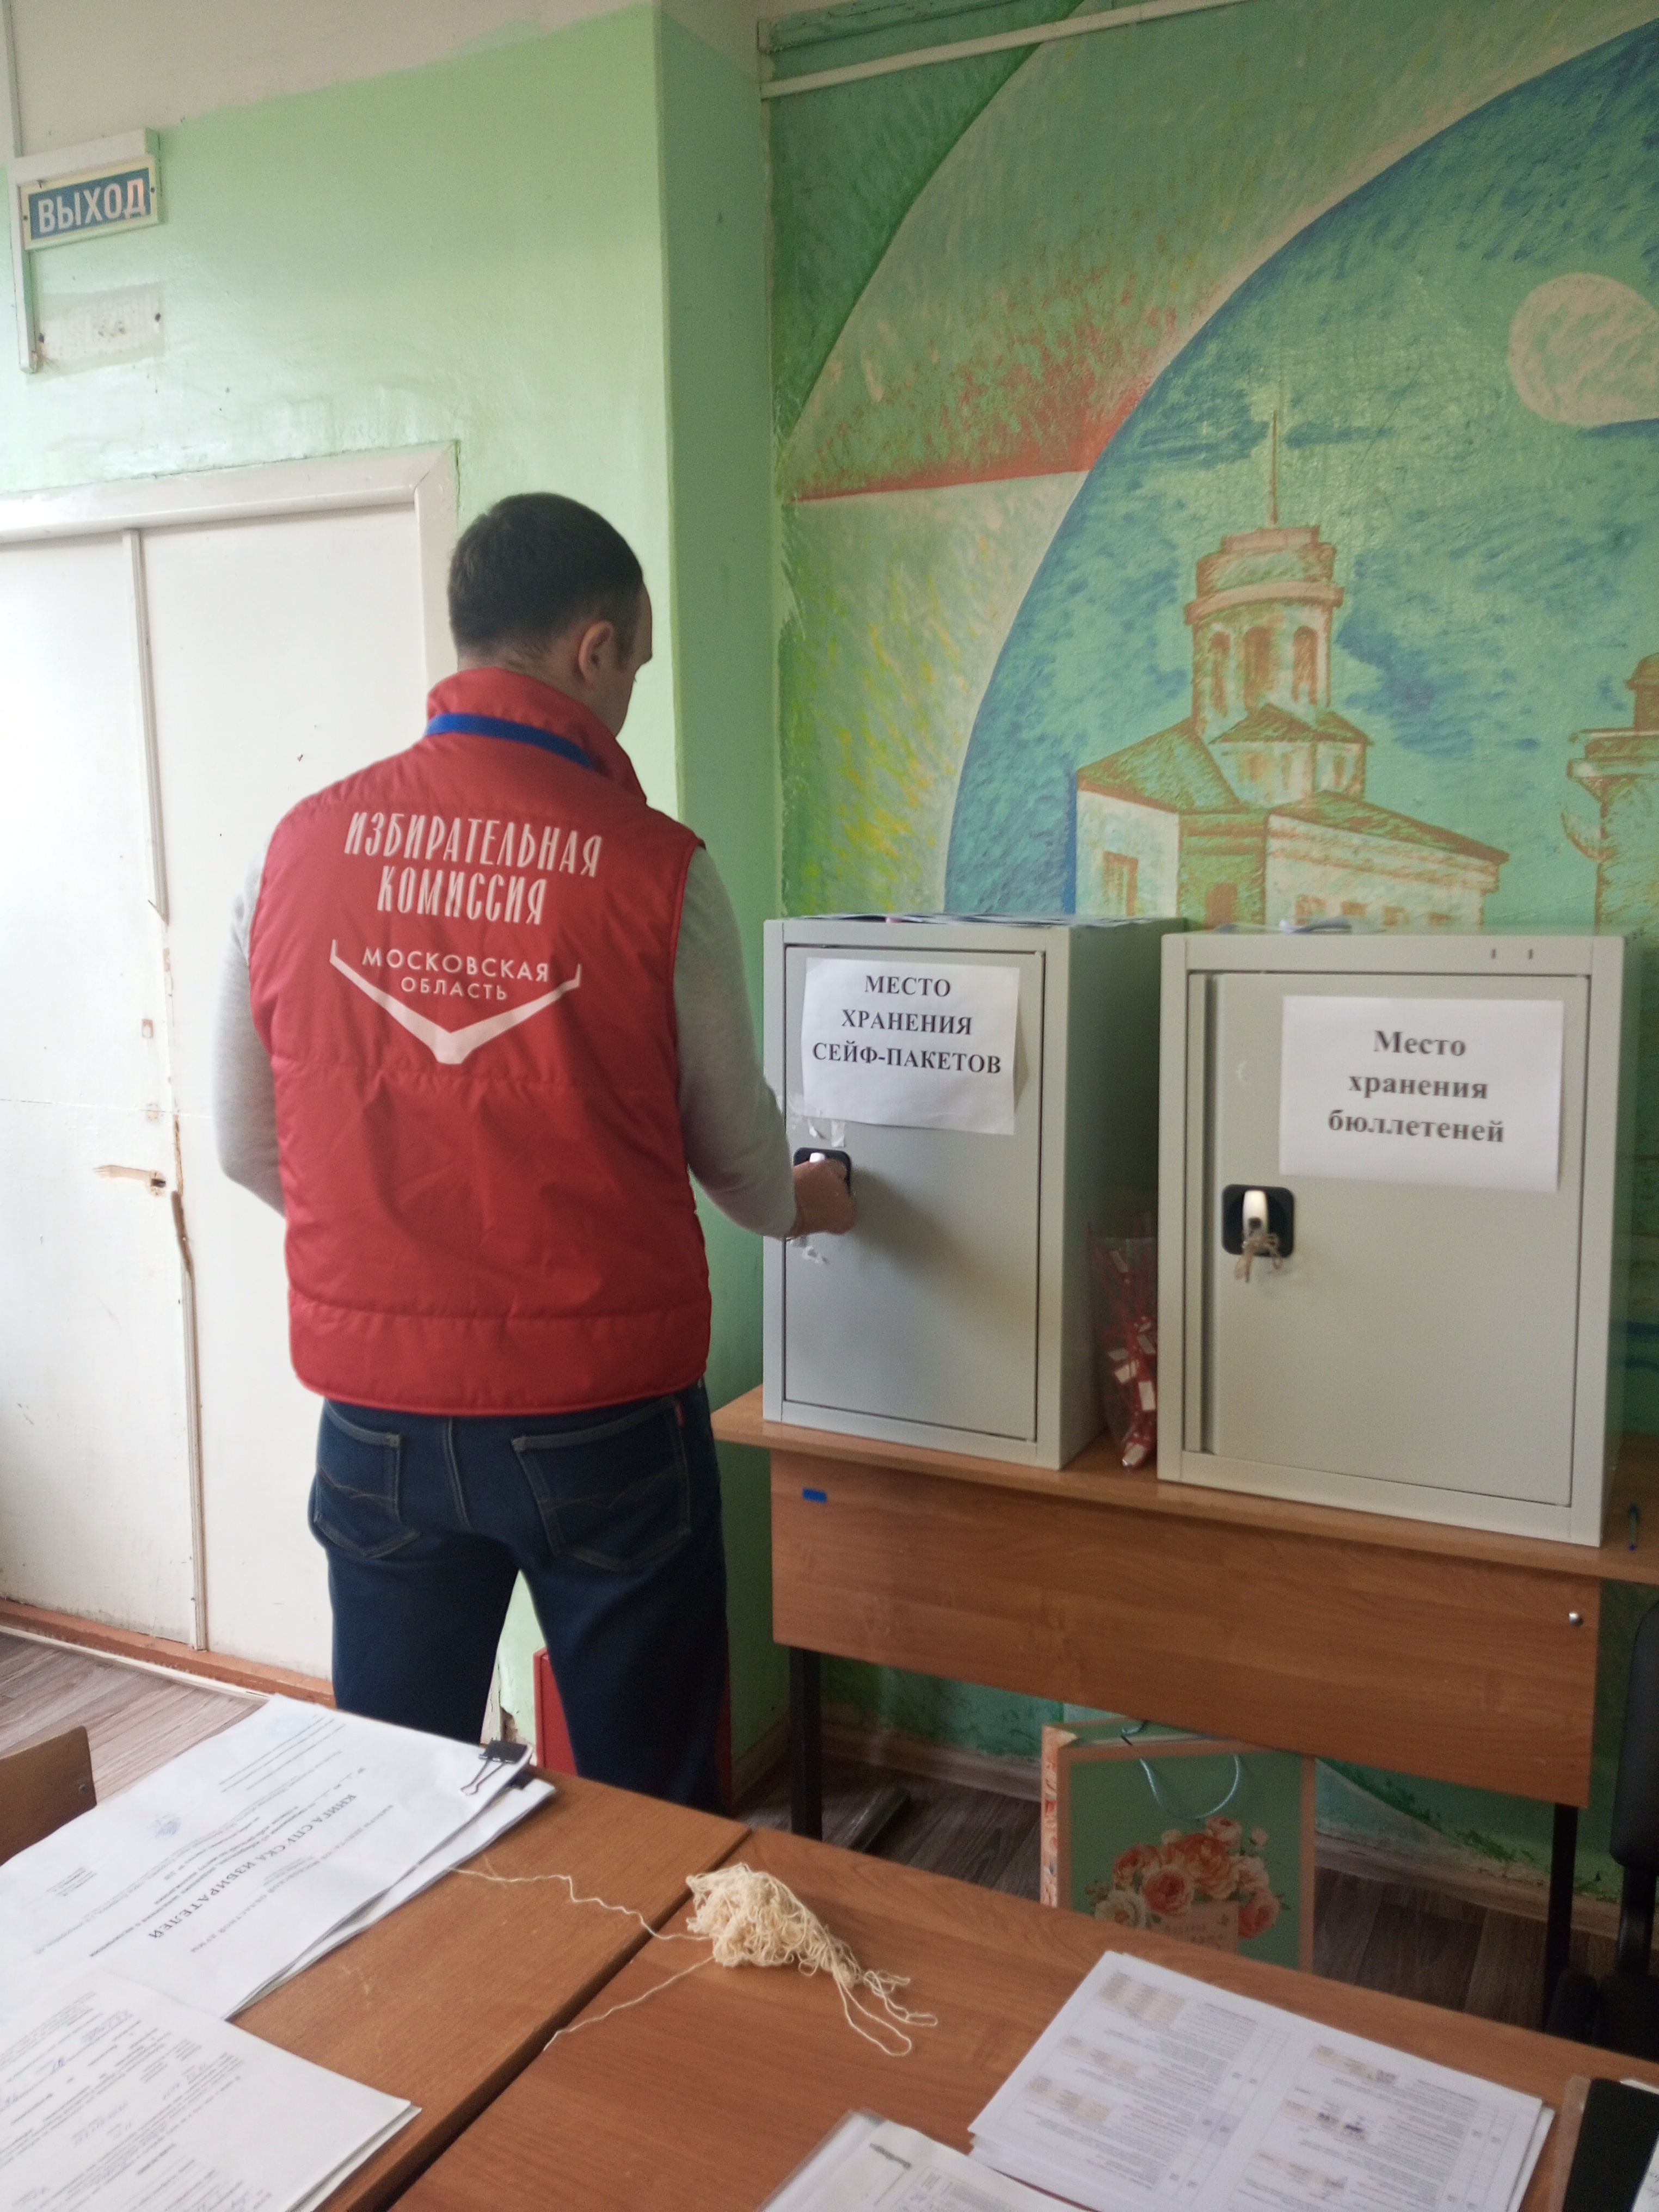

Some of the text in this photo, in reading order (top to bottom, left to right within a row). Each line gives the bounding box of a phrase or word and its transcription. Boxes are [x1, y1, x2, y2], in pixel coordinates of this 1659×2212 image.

[38, 178, 147, 234] ВЫХОД
[344, 812, 602, 877] ИЗБИРАТЕЛЬНАЯ
[377, 865, 546, 925] КОМИССИЯ
[361, 947, 549, 982] МОСКОВСКАЯ
[401, 977, 507, 1000] ОБЛАСТЬ
[865, 975, 951, 997] МЕСТО
[841, 1009, 973, 1035] ХРАНЕНИЯ
[812, 1040, 1001, 1074] СЕЙФ-ПАКЕТОВ
[1373, 1030, 1466, 1056] Место
[1349, 1075, 1488, 1099] хранения
[1328, 1109, 1504, 1143] бюллетеней
[312, 1794, 357, 1824] КНИГА
[148, 1861, 255, 1939] ИЗБИРАТЕЛЕЙ
